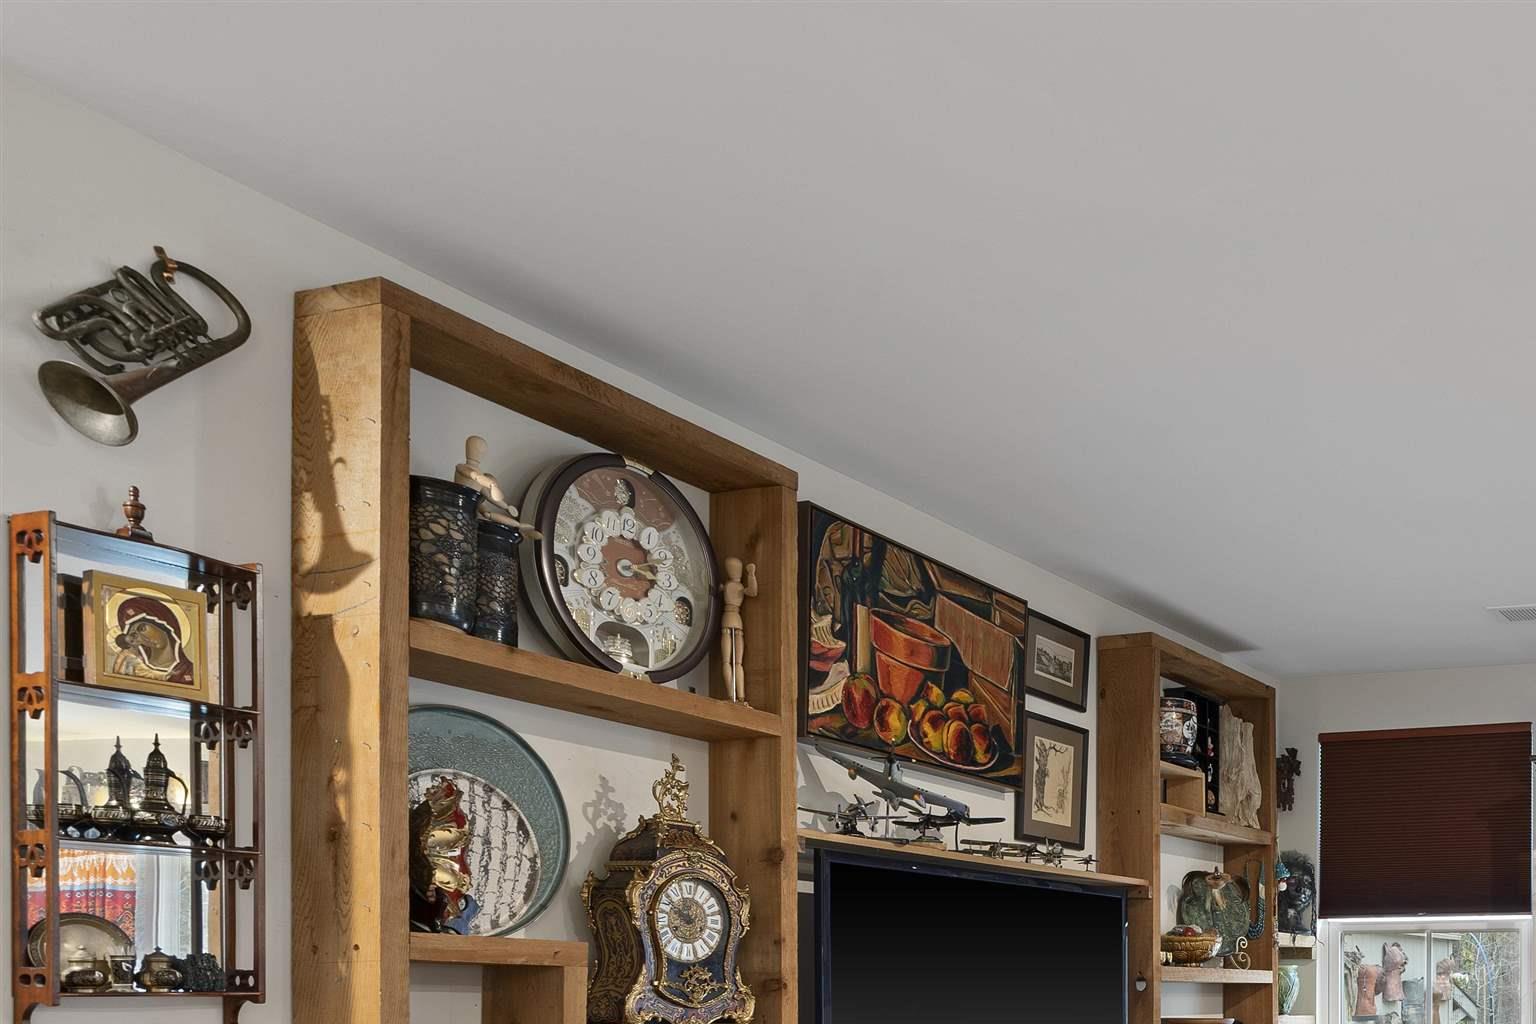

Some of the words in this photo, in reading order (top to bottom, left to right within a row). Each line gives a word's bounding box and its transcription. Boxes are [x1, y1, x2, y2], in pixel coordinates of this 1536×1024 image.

[622, 517, 635, 534] 12
[591, 527, 604, 542] 10
[586, 546, 596, 560] 9
[588, 570, 598, 586] 8
[662, 574, 672, 588] 3
[607, 590, 616, 606] 7
